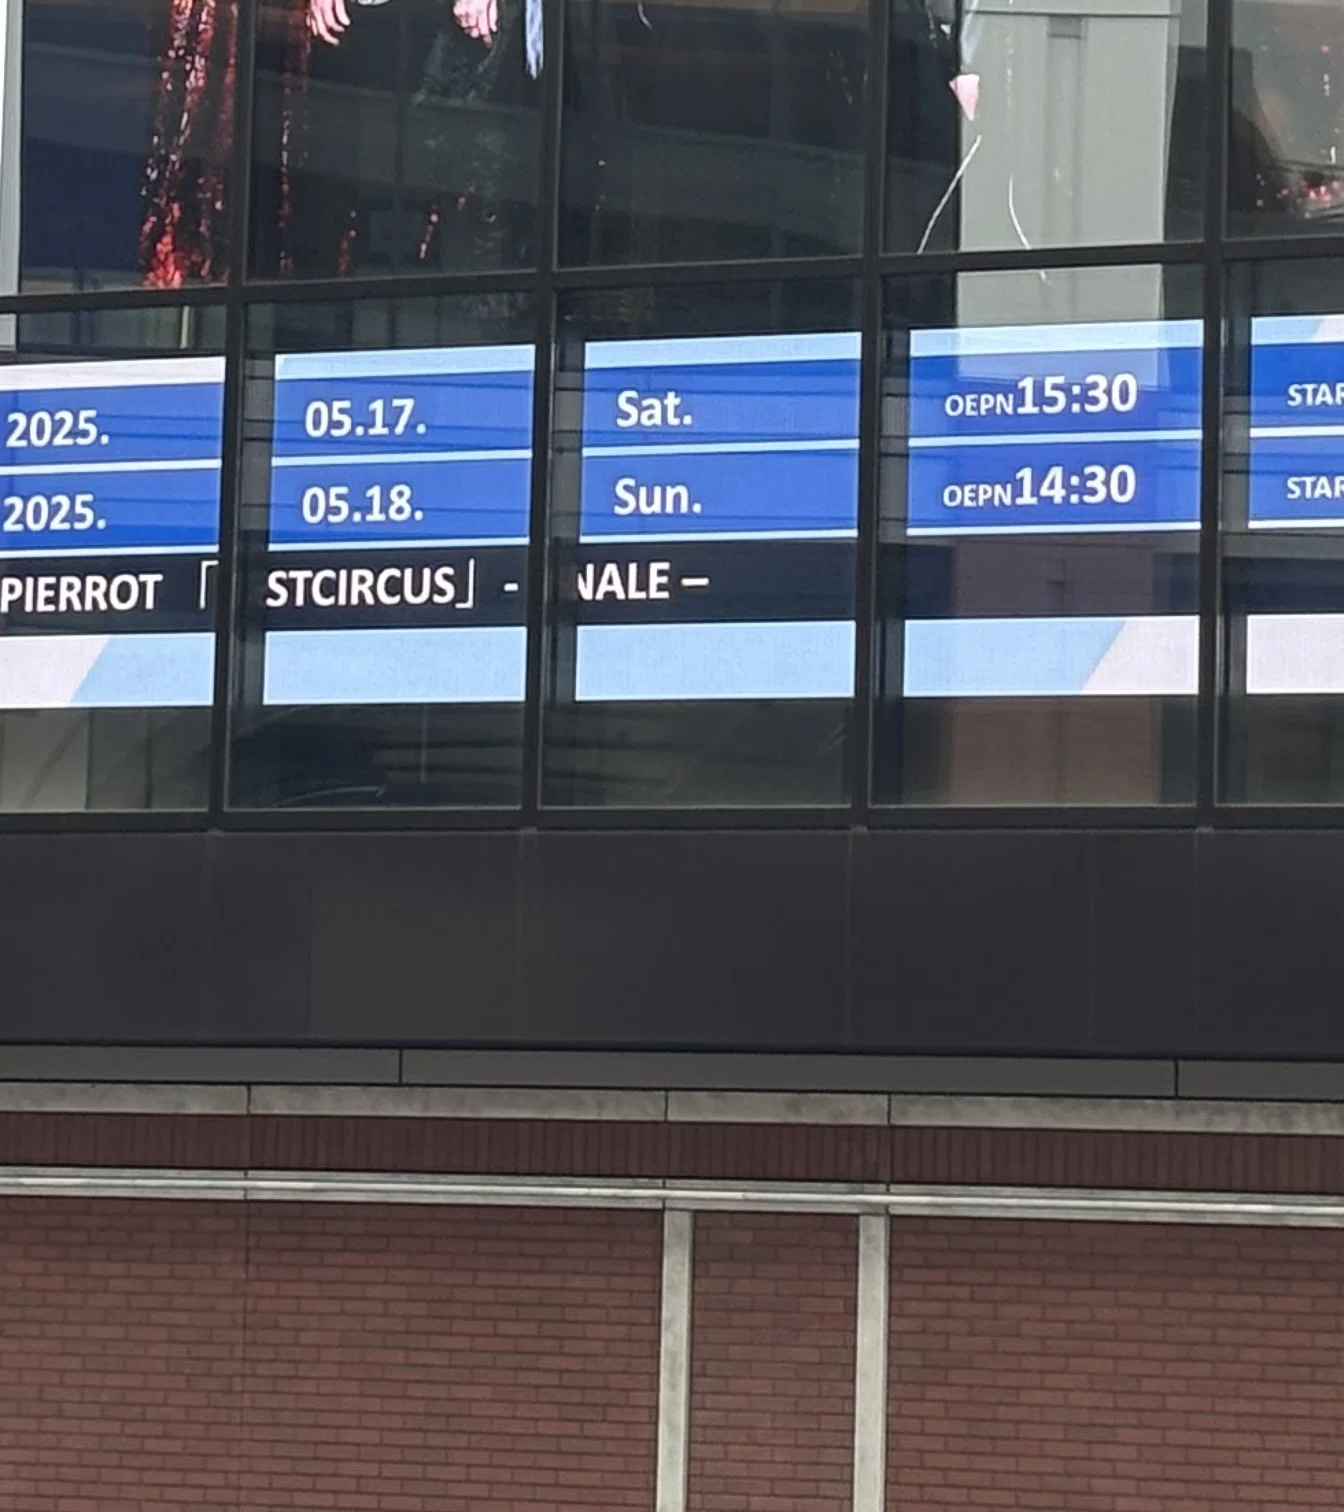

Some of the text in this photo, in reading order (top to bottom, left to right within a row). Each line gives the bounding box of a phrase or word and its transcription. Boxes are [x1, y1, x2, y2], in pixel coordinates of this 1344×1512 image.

[5, 408, 110, 448] 2025.
[304, 397, 427, 439] 05.17.
[615, 389, 694, 429] Sat.
[2, 492, 107, 533] 2025.
[301, 483, 424, 525] 05.18.
[613, 476, 703, 516] Sun.
[576, 560, 671, 602] NALE
